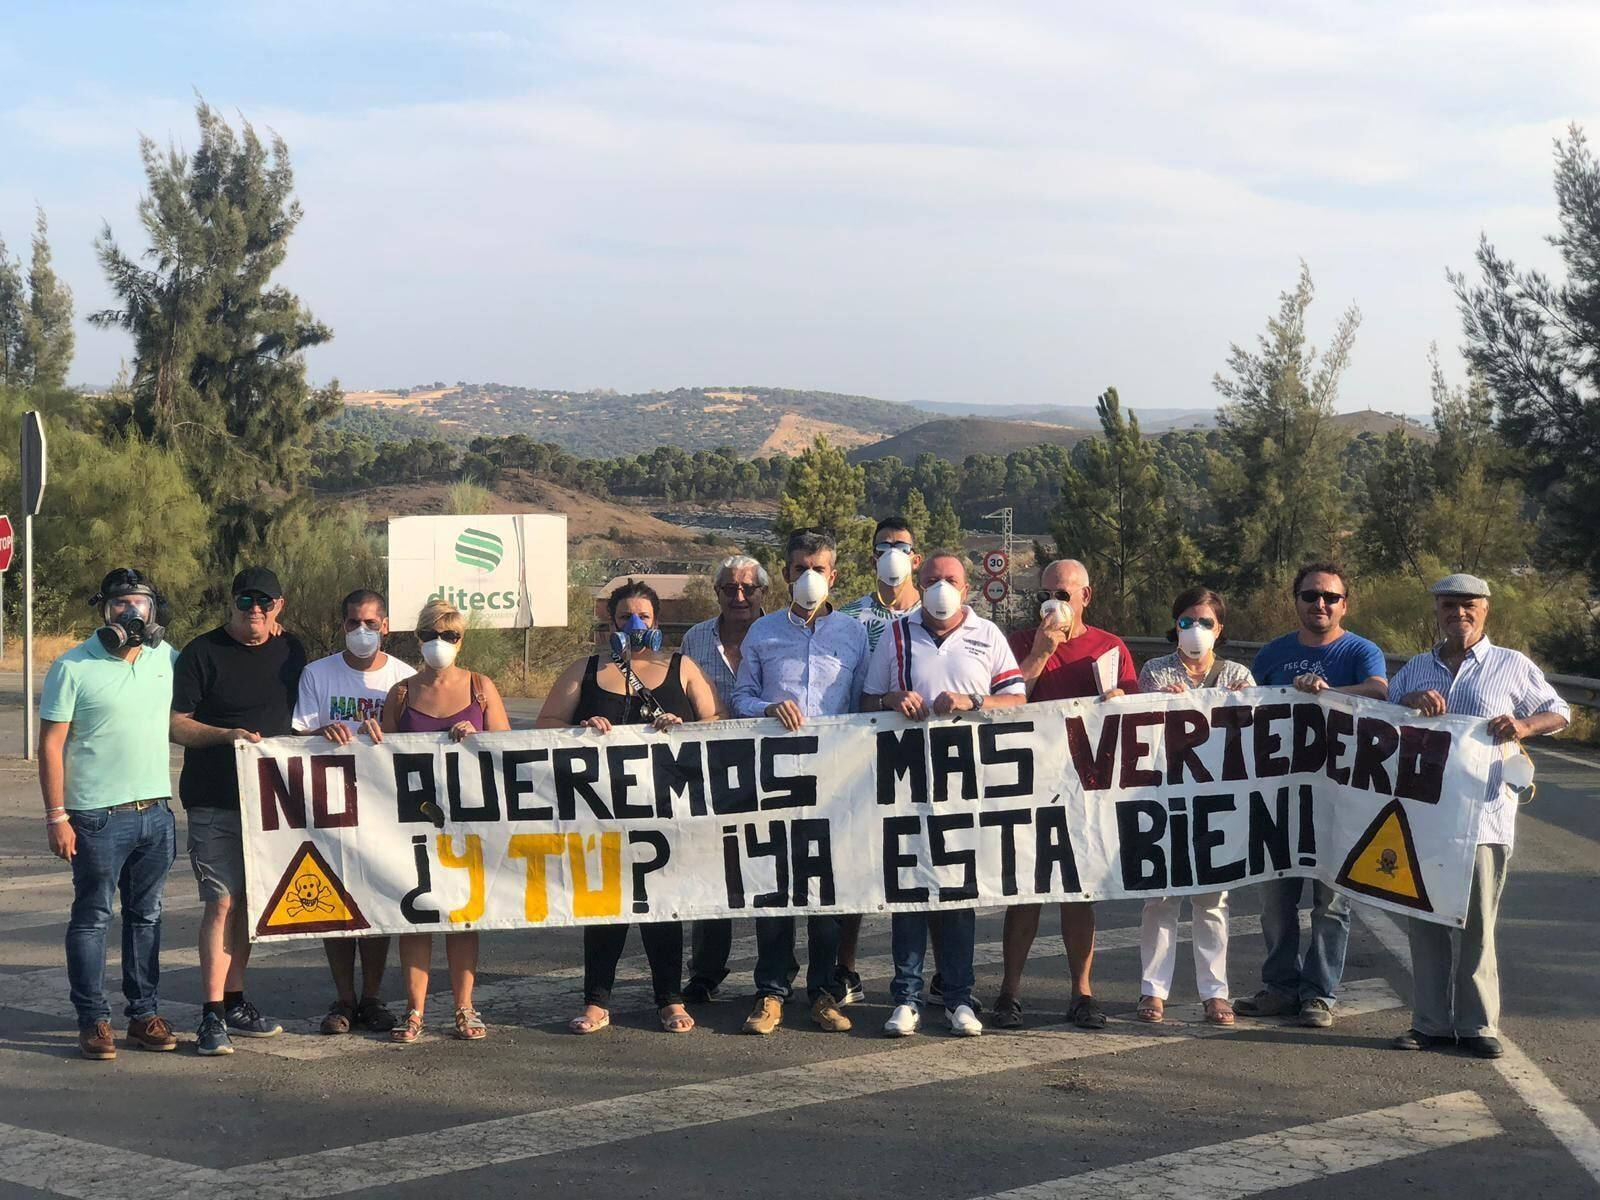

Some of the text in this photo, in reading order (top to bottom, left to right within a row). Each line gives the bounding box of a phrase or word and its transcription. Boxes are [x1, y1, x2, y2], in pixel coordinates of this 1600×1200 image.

[0, 536, 11, 551] TOP
[990, 558, 1003, 568] 30
[257, 703, 1451, 831] NO QUEREMOS MÁS VERTEDERO
[400, 833, 485, 924] ¿Y
[723, 818, 836, 909] ¡YA
[883, 793, 1082, 904] ESTÁ
